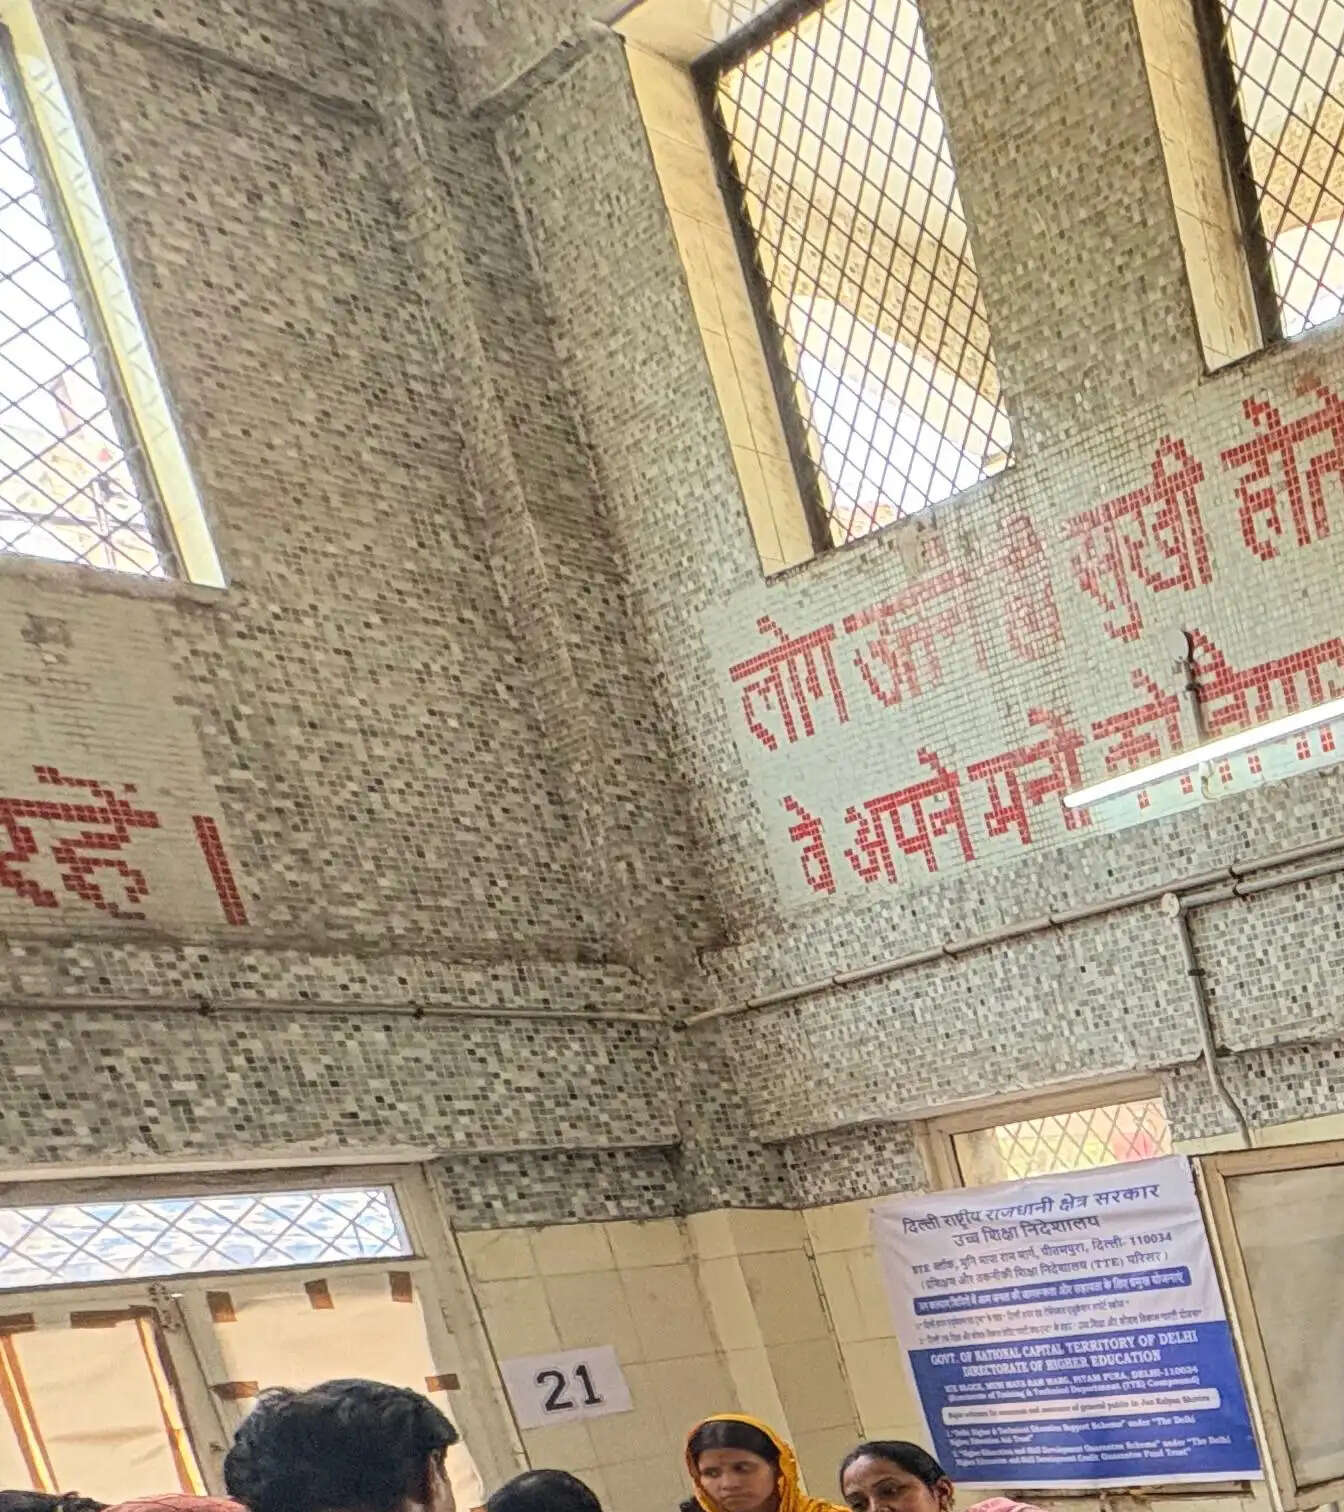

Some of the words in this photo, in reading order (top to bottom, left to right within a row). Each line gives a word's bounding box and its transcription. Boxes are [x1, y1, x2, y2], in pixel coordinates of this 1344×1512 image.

[729, 615, 850, 752] लोग
[1062, 435, 1213, 642] सुखी
[782, 796, 837, 894] वे
[845, 746, 975, 885] अपने
[903, 1214, 941, 1235] दिल्ली
[941, 1209, 982, 1231] राष्ट्रीय
[986, 1197, 1054, 1223] राजधानी
[1058, 1193, 1088, 1212] क्षेत्र
[1092, 1183, 1160, 1208] सरकार
[952, 1228, 980, 1248] उच्च
[982, 1223, 1019, 1245] शिक्षा
[1022, 1214, 1100, 1238] निदेशालय
[1130, 1231, 1173, 1246] 110034
[1090, 1256, 1124, 1271] (TTE)
[960, 1351, 972, 1363] OF
[976, 1348, 1019, 1362] NATIONAL
[1022, 1344, 1064, 1358] CAPITAL
[1065, 1337, 1137, 1356] TERRITORY
[1140, 1335, 1155, 1347] OF
[1159, 1329, 1198, 1345] DELHI
[964, 1361, 1027, 1377] DIRECTORATE
[1030, 1360, 1044, 1372] OF
[1047, 1356, 1087, 1371] HIGHER
[1091, 1350, 1161, 1367] EDUCATION
[536, 1365, 603, 1411] 21
